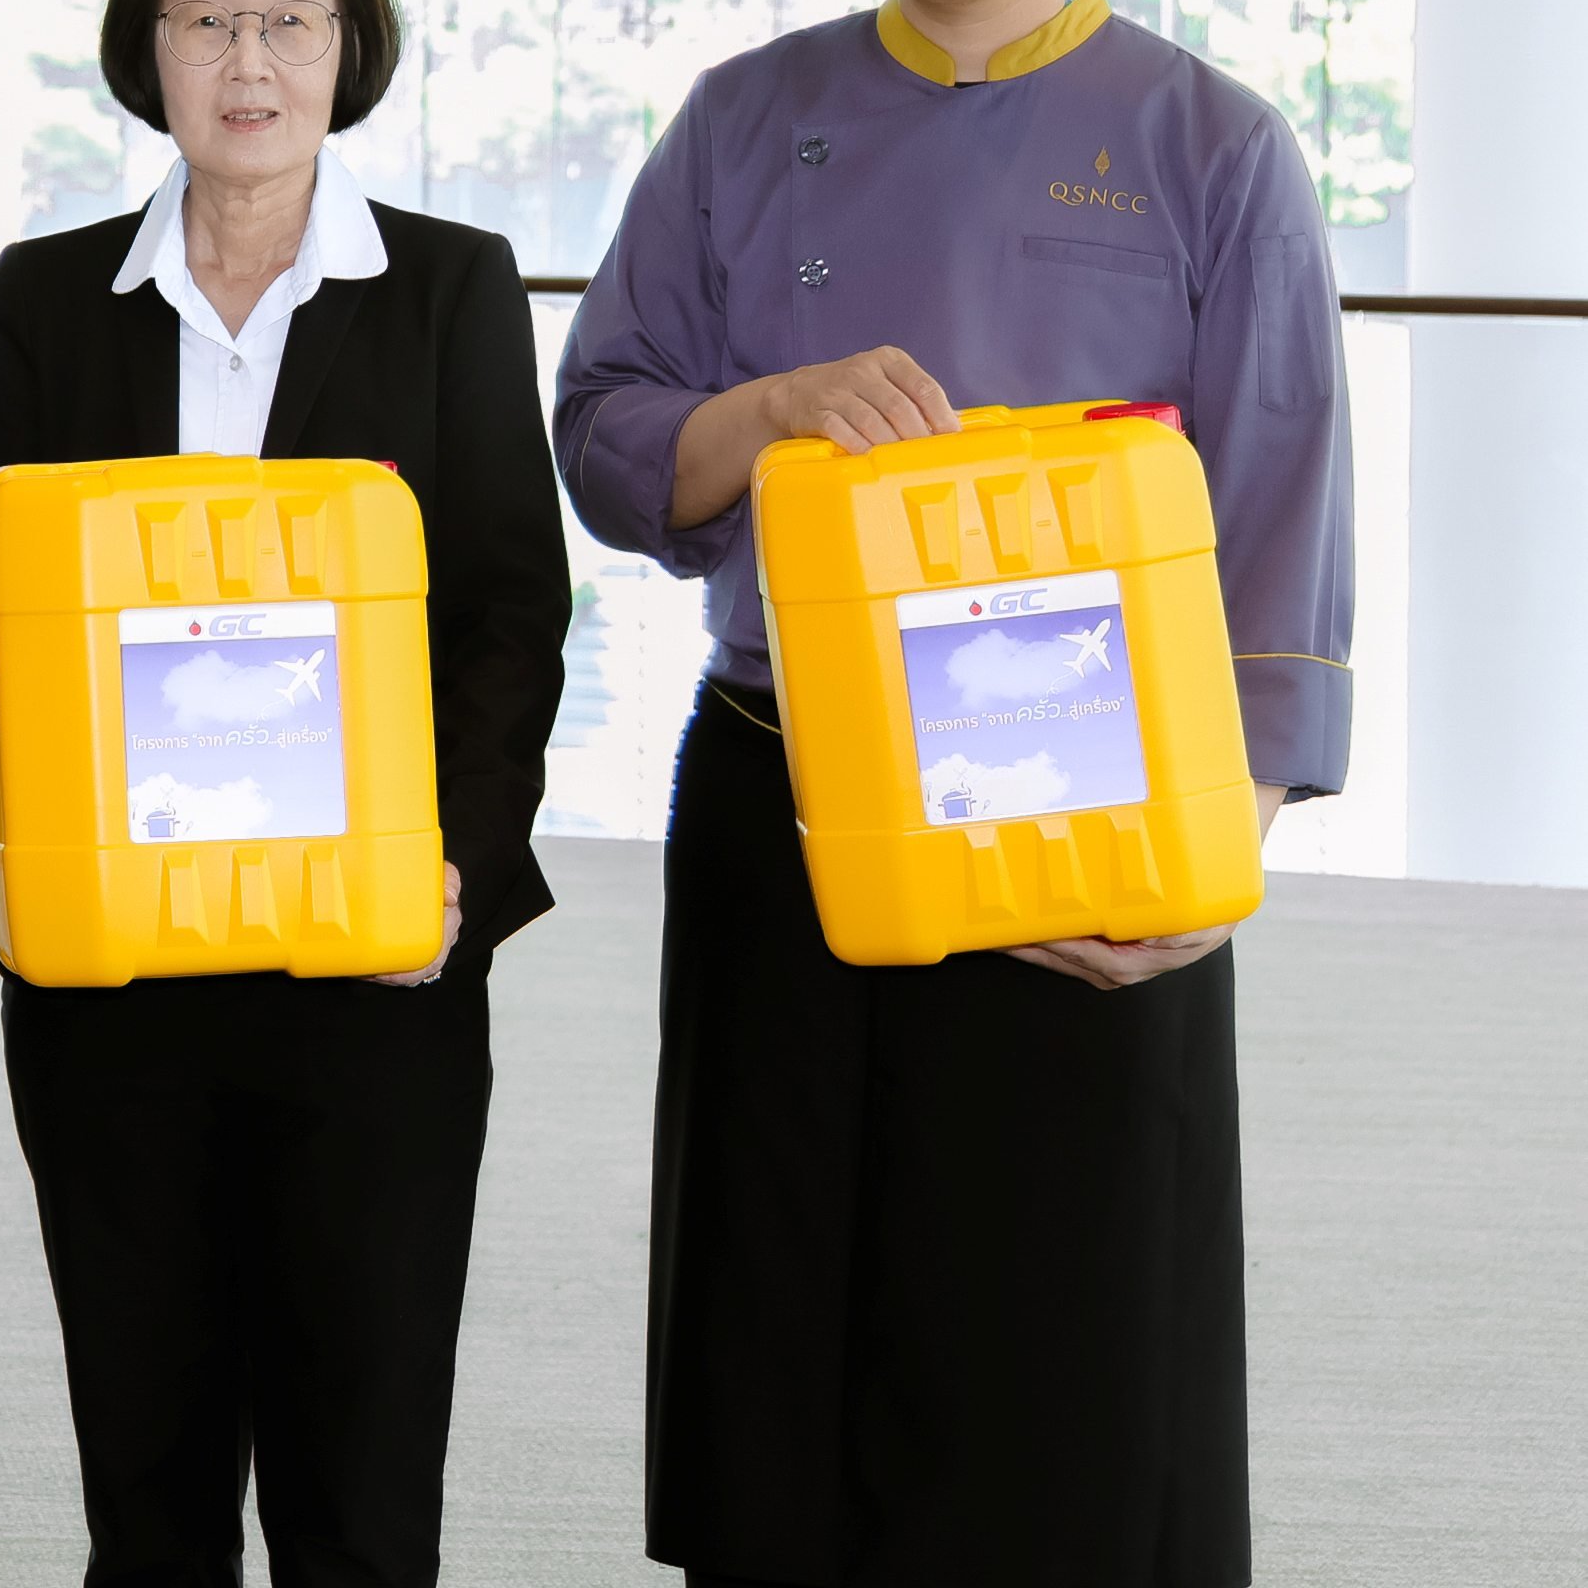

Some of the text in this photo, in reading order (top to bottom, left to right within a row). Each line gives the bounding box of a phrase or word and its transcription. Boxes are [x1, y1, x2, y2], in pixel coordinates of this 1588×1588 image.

[1049, 181, 1149, 215] QSNCC
[989, 588, 1049, 615] GC
[208, 613, 267, 637] GC
[919, 715, 979, 734] โครงการ
[131, 734, 189, 751] โครงการ
